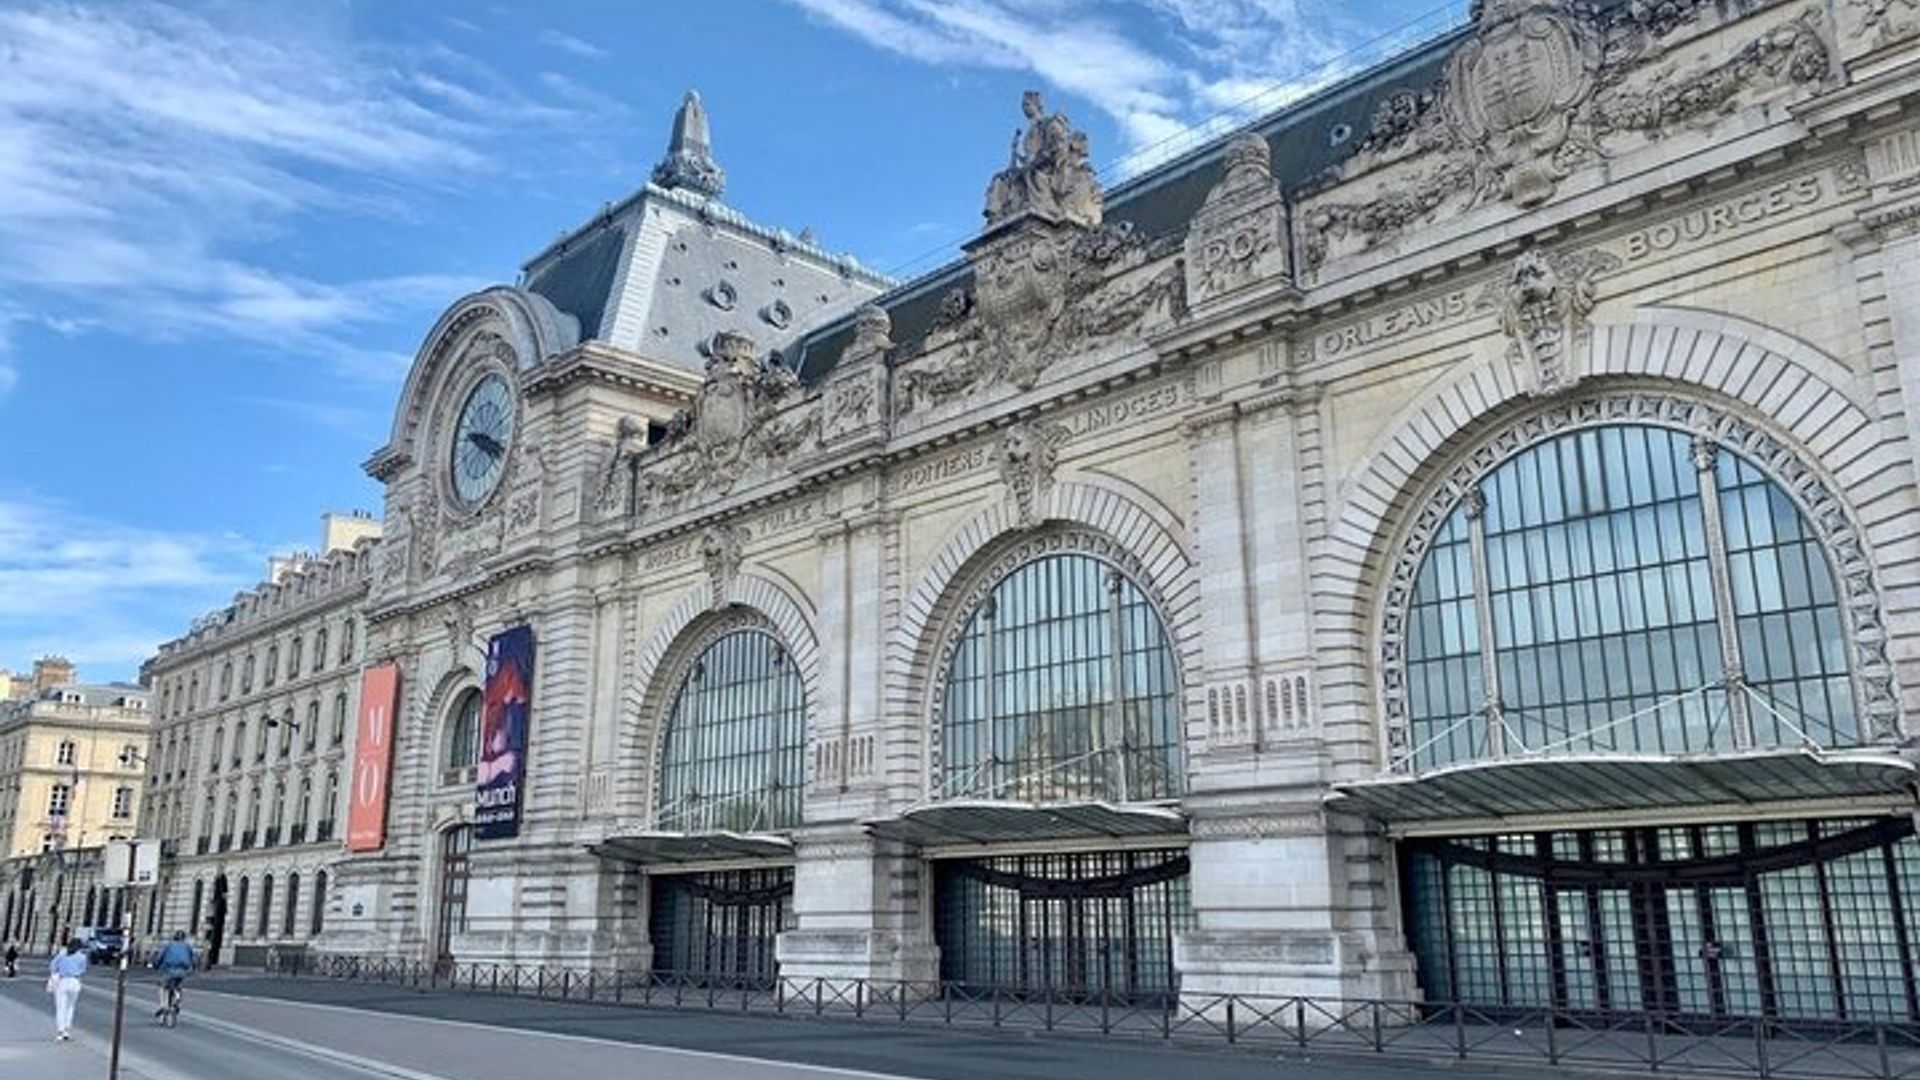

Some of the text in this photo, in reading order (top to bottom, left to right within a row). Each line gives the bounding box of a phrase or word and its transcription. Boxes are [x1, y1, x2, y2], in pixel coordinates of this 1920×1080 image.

[1323, 291, 1466, 355] ORLEANS
[1074, 385, 1178, 437] LIMOGES
[901, 448, 985, 490] POITIERS
